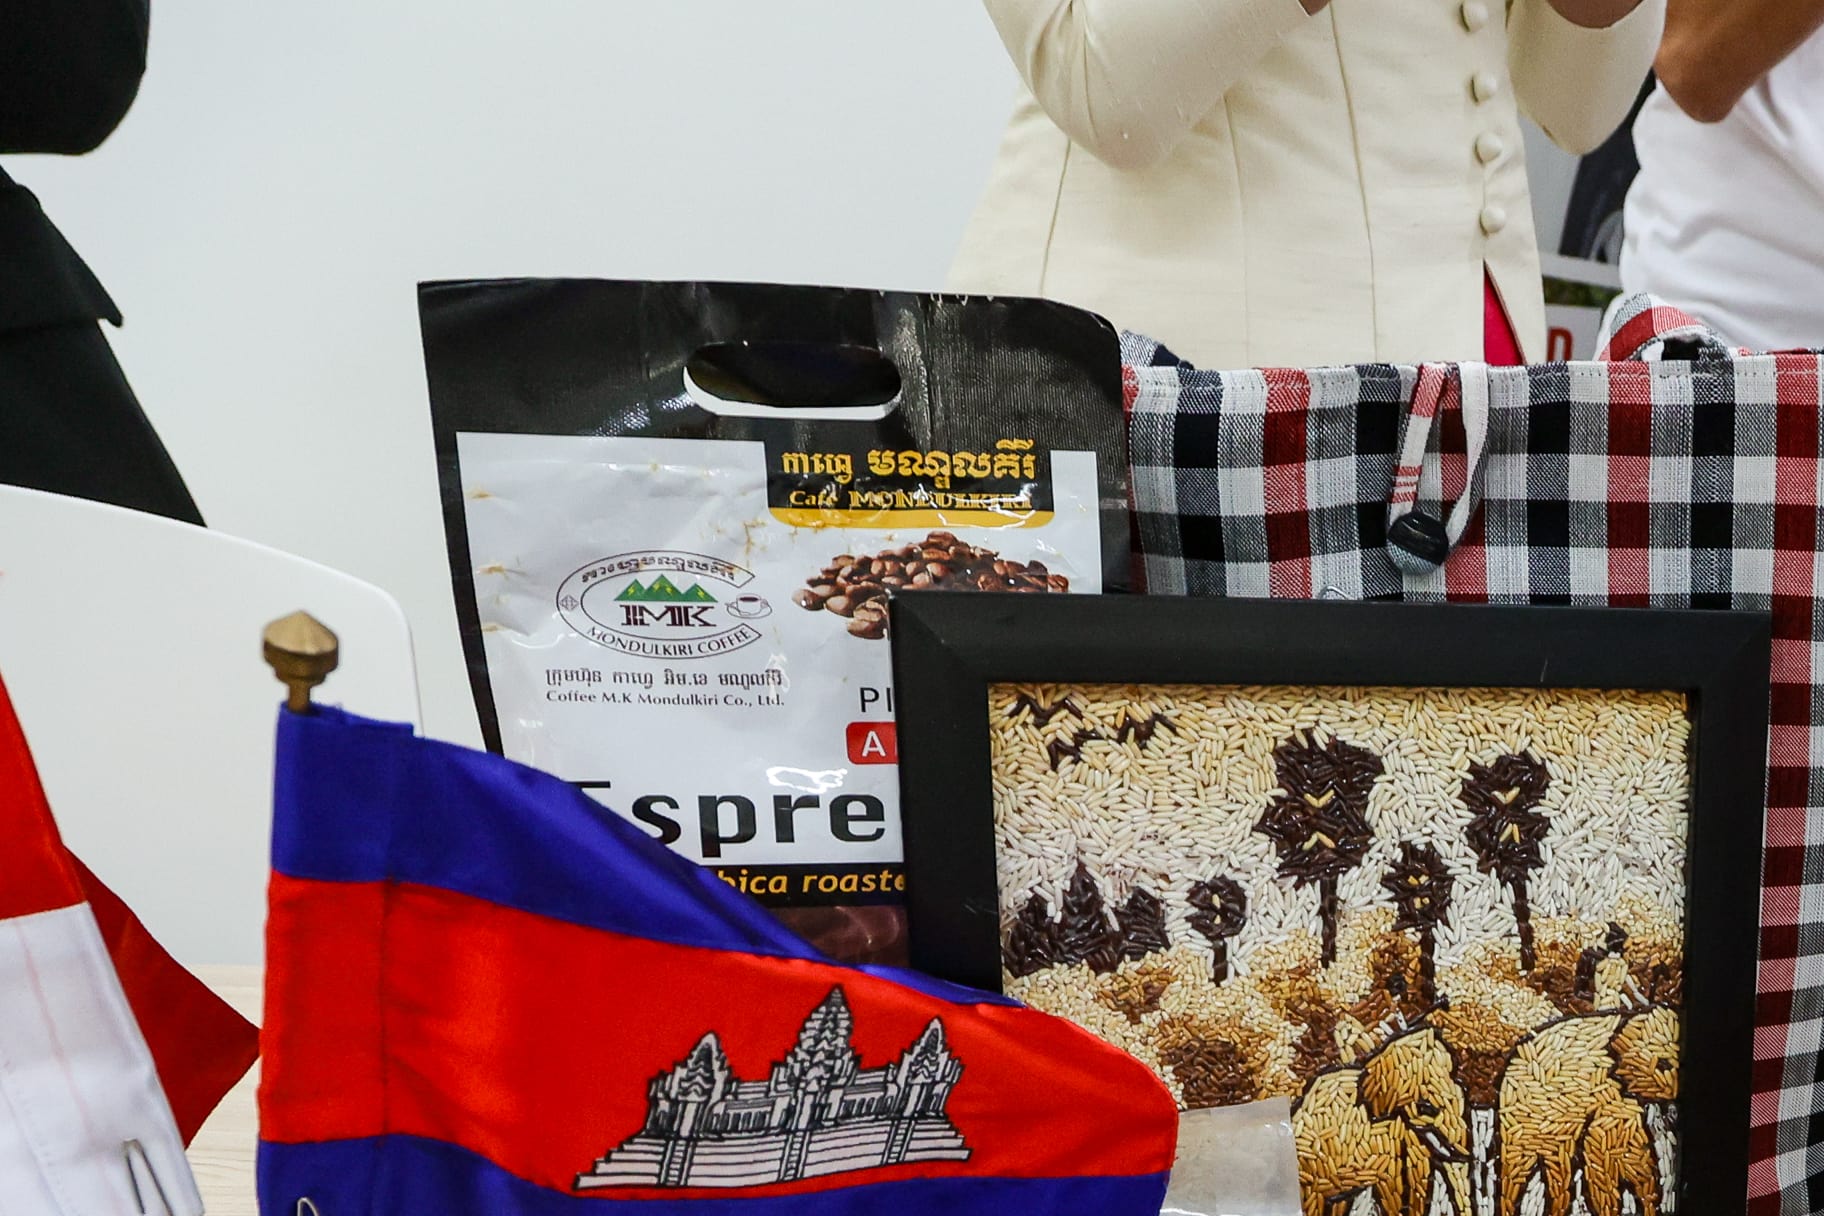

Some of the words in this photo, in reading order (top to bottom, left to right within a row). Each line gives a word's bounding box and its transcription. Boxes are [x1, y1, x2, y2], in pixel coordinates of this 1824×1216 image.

[586, 626, 693, 657] MONDULKIRI
[697, 627, 752, 654] COFFEE
[545, 688, 597, 703] Coffee
[601, 691, 632, 705] M.K
[637, 693, 719, 707] Mondulkiri
[757, 693, 785, 707] Ltd.
[578, 780, 886, 859] spre
